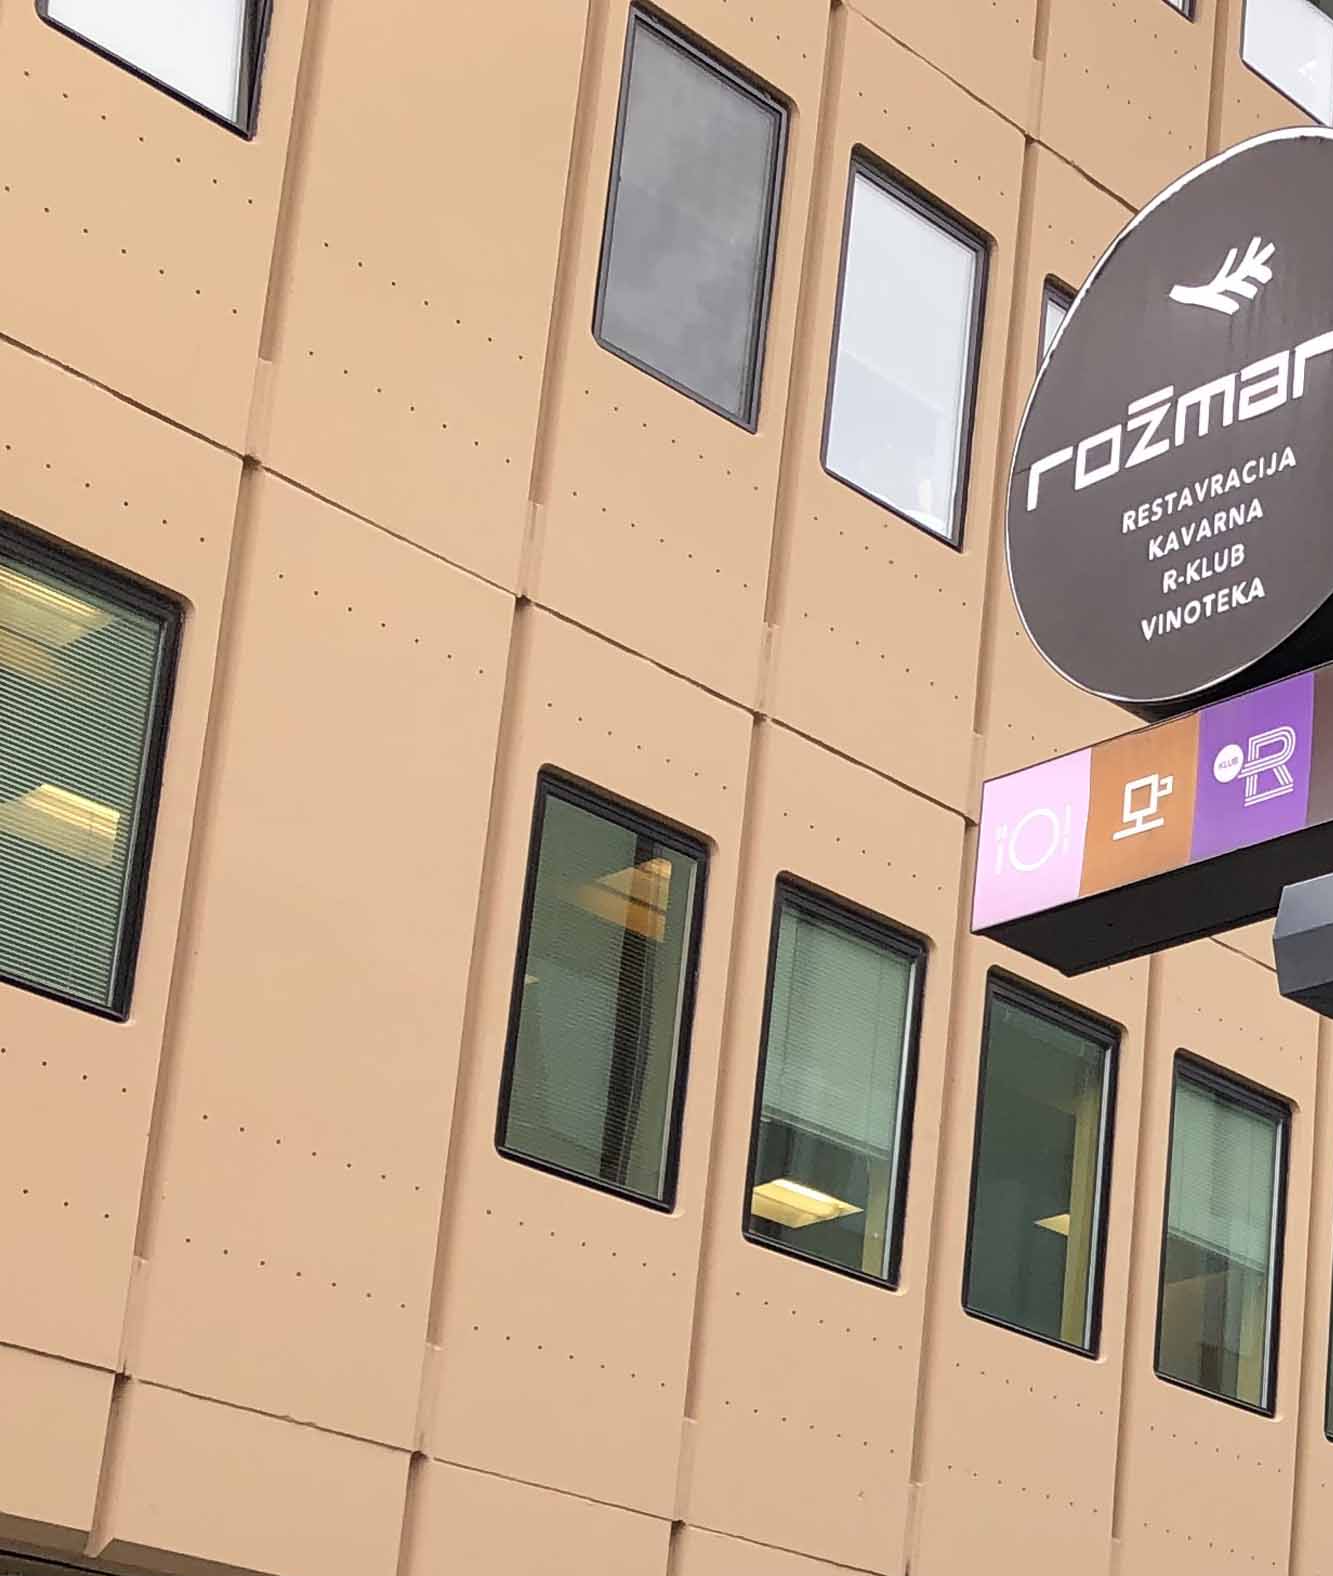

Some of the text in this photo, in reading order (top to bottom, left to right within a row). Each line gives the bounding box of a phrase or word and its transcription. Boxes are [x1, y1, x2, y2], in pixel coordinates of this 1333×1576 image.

[1121, 446, 1296, 534] RESTAVRACIJA
[1149, 498, 1264, 561] KAVARNA
[1162, 543, 1245, 594] R-KLUB
[1140, 576, 1265, 641] VINOTEKA
